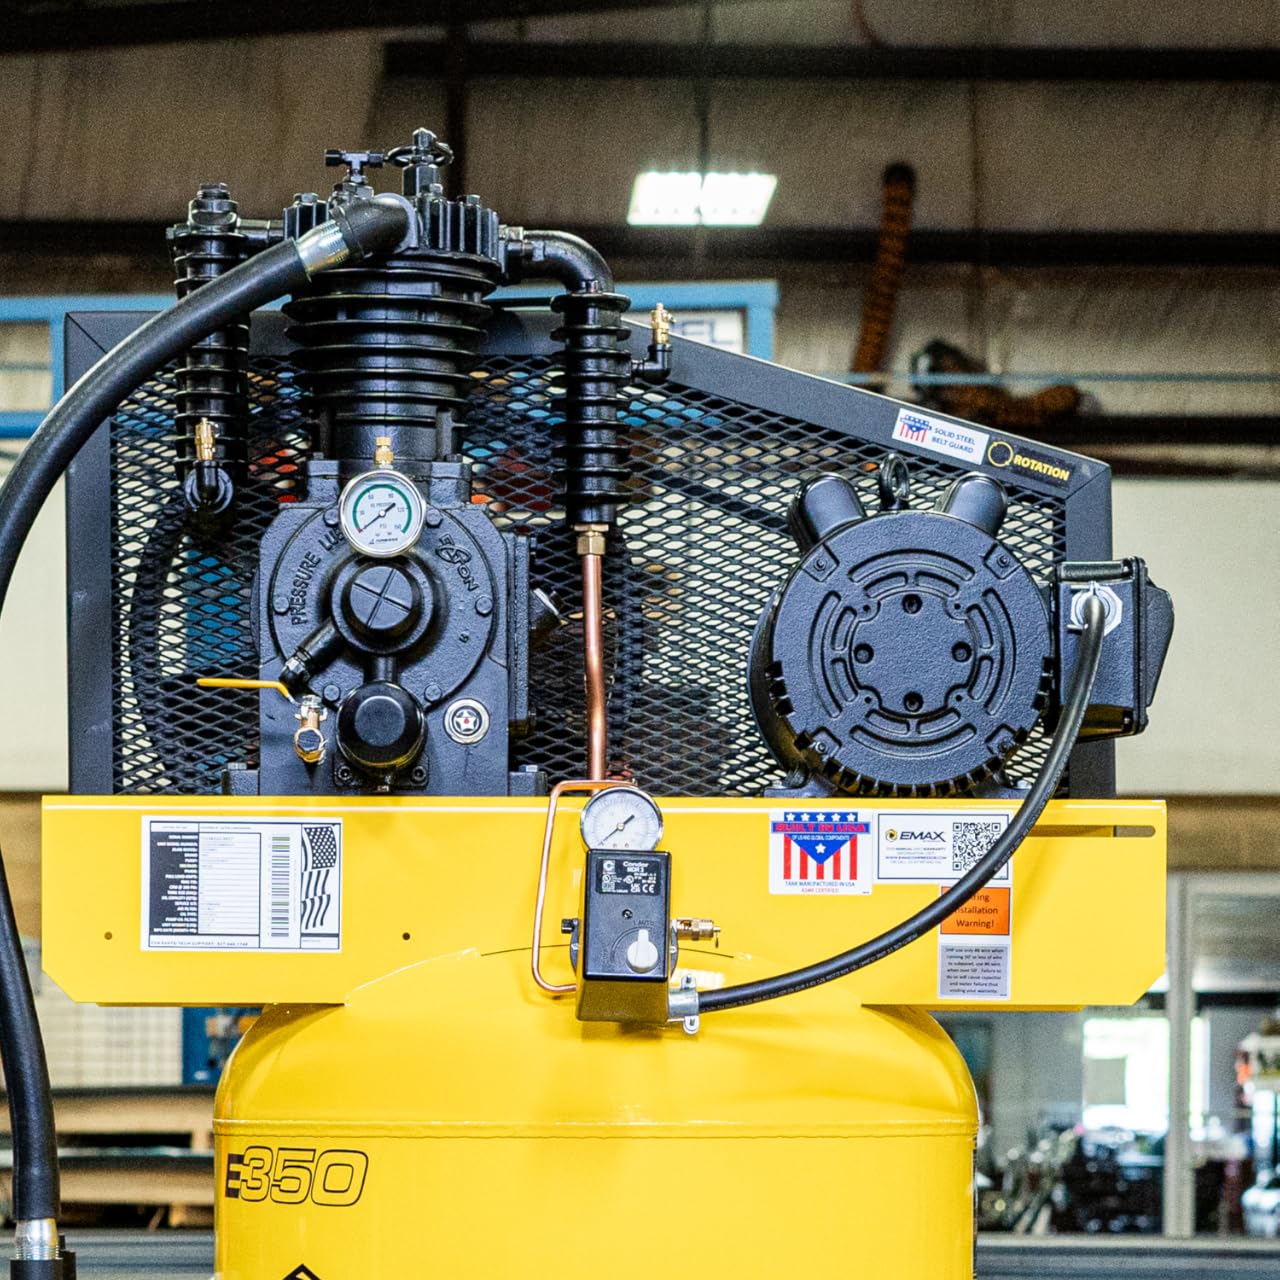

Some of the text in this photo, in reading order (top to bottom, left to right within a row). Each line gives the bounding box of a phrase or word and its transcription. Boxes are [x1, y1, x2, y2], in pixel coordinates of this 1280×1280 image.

[931, 436, 947, 445] BELT
[935, 427, 976, 445] SOLID STEEL
[1014, 454, 1070, 480] ROTATION
[290, 551, 321, 626] PRESSURE
[775, 823, 866, 832] BUILT IN USA
[900, 831, 946, 842] EMAX
[956, 919, 995, 928] Warning!
[225, 1145, 369, 1207] E350
